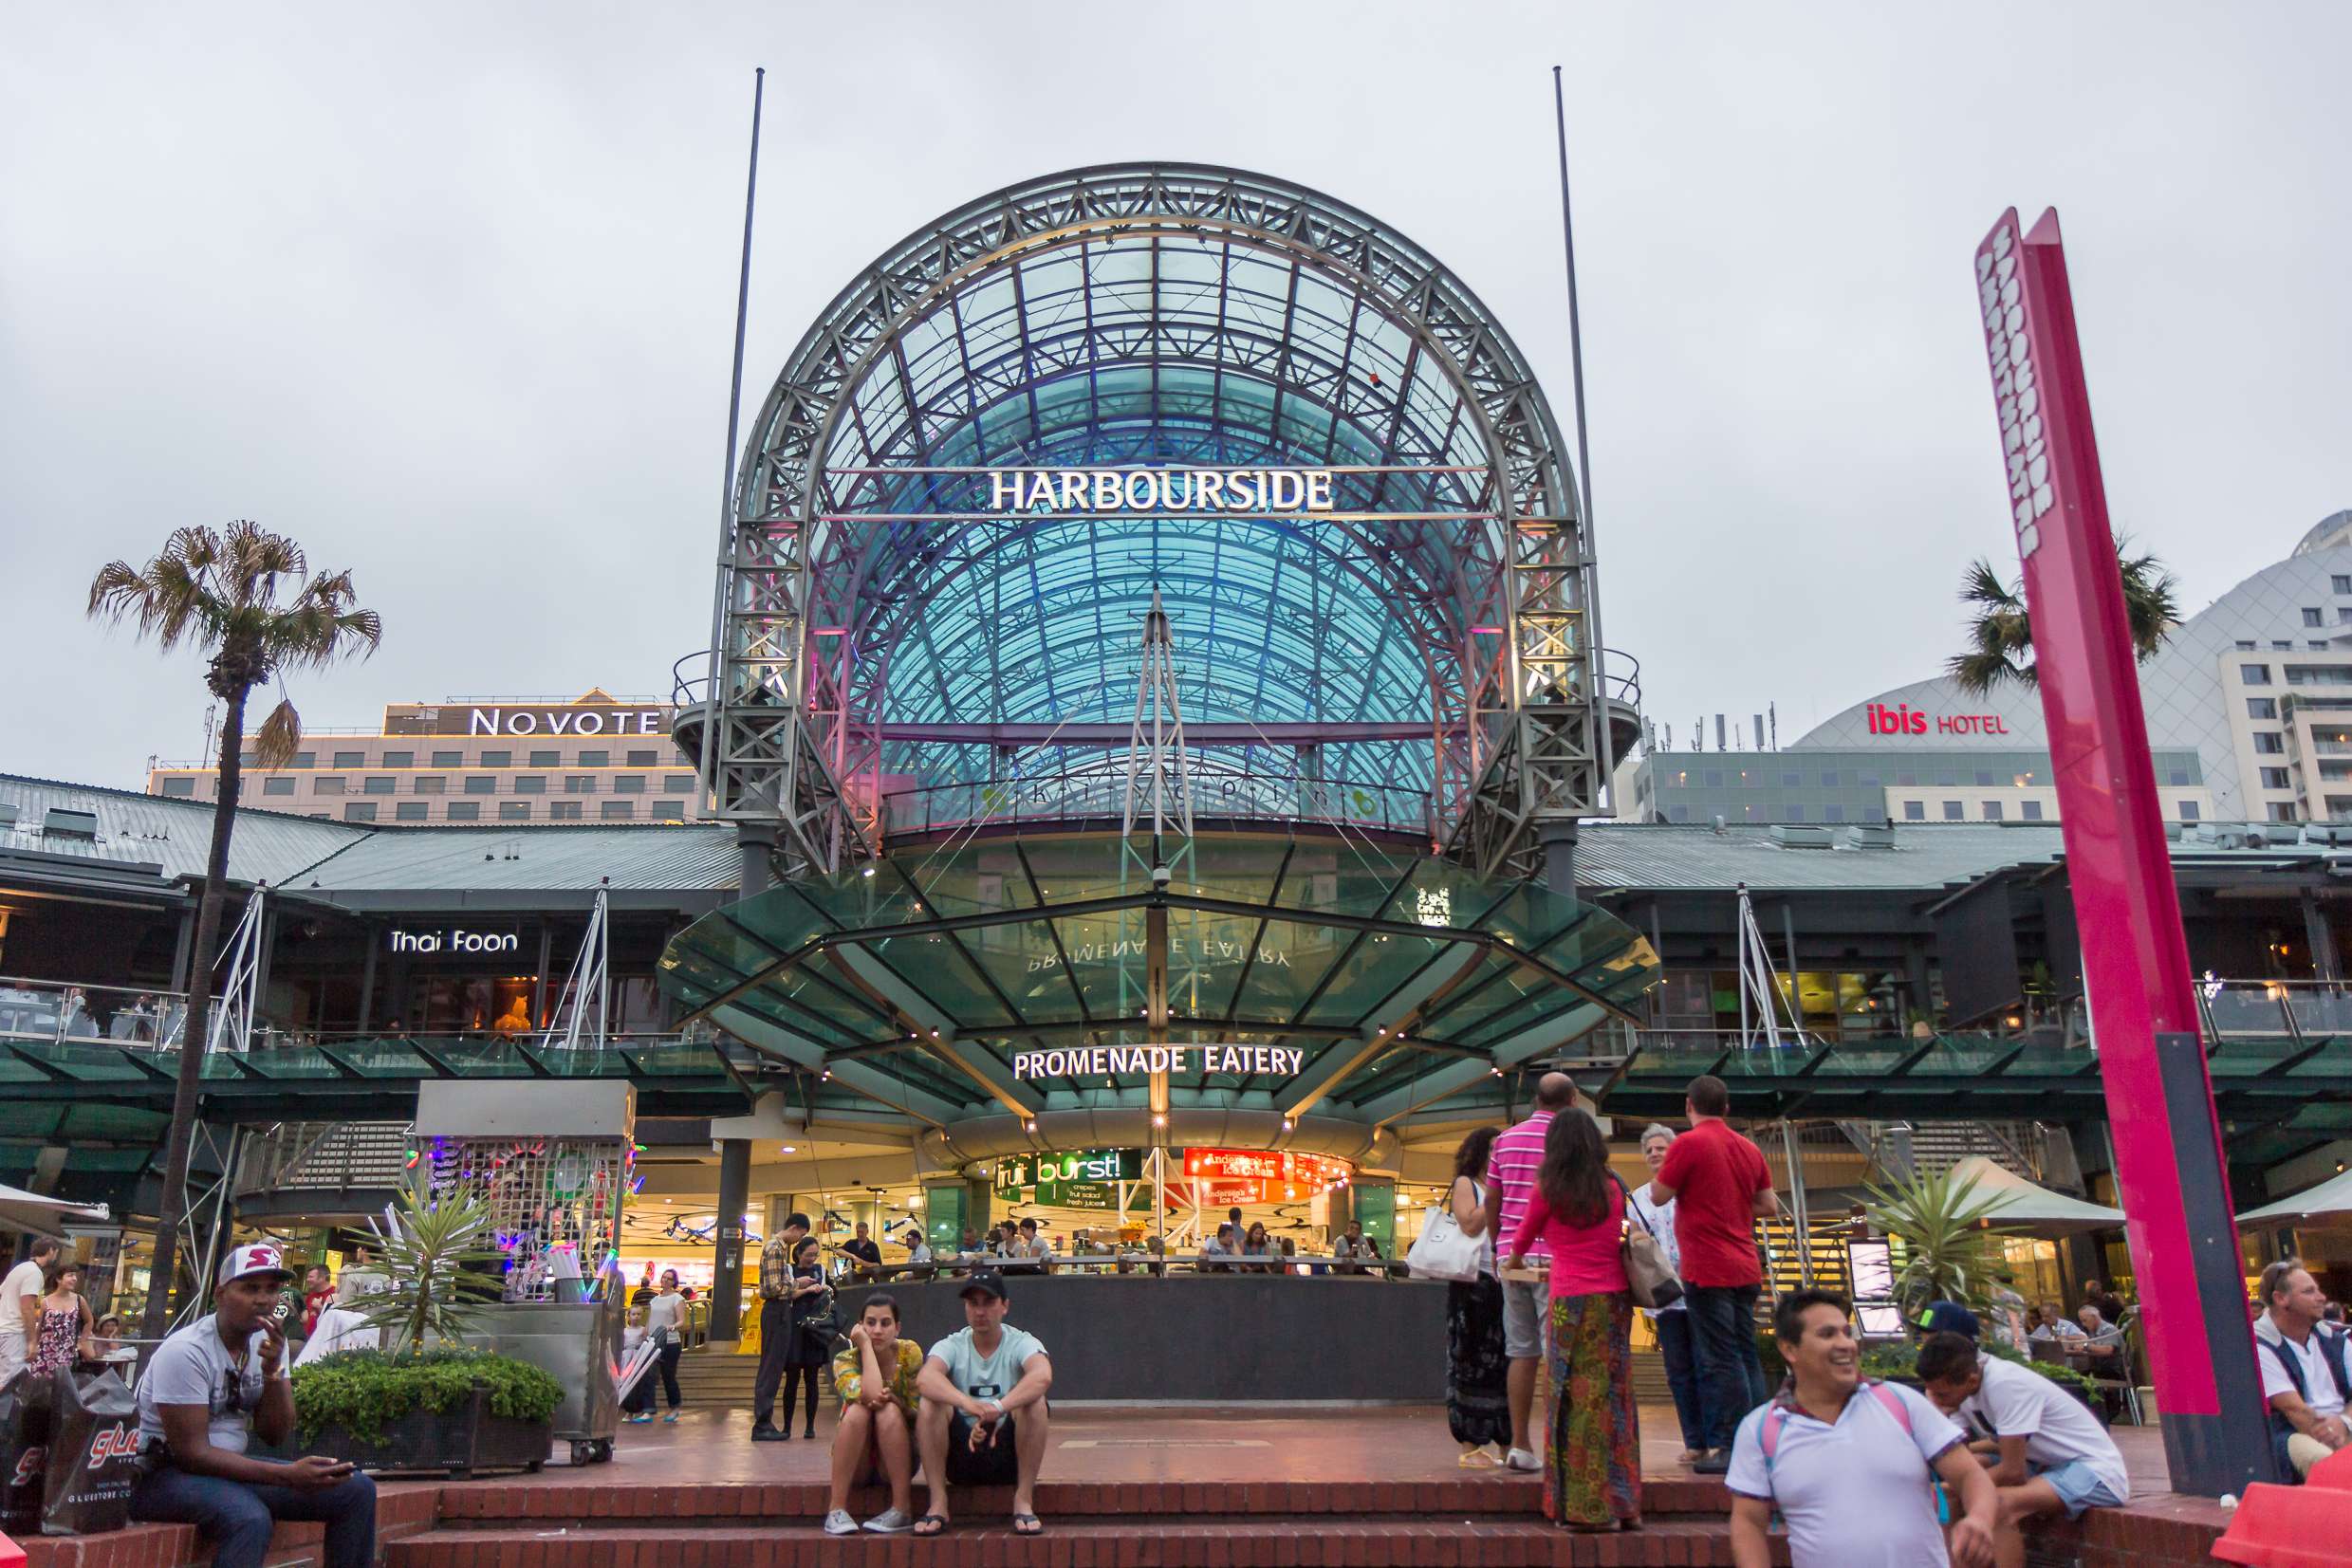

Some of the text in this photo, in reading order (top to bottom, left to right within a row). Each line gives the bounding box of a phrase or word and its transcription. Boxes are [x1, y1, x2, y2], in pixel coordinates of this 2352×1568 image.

[991, 470, 1334, 510] HARBOURSIDE
[471, 708, 661, 735] NOVOTE
[1866, 704, 2009, 734] ibis HOTEL
[391, 931, 518, 951] Thai Foon
[1013, 1045, 1305, 1080] PROMENADE EATERY
[997, 1153, 1121, 1188] fruit burst!
[1242, 1163, 1276, 1177] Cream
